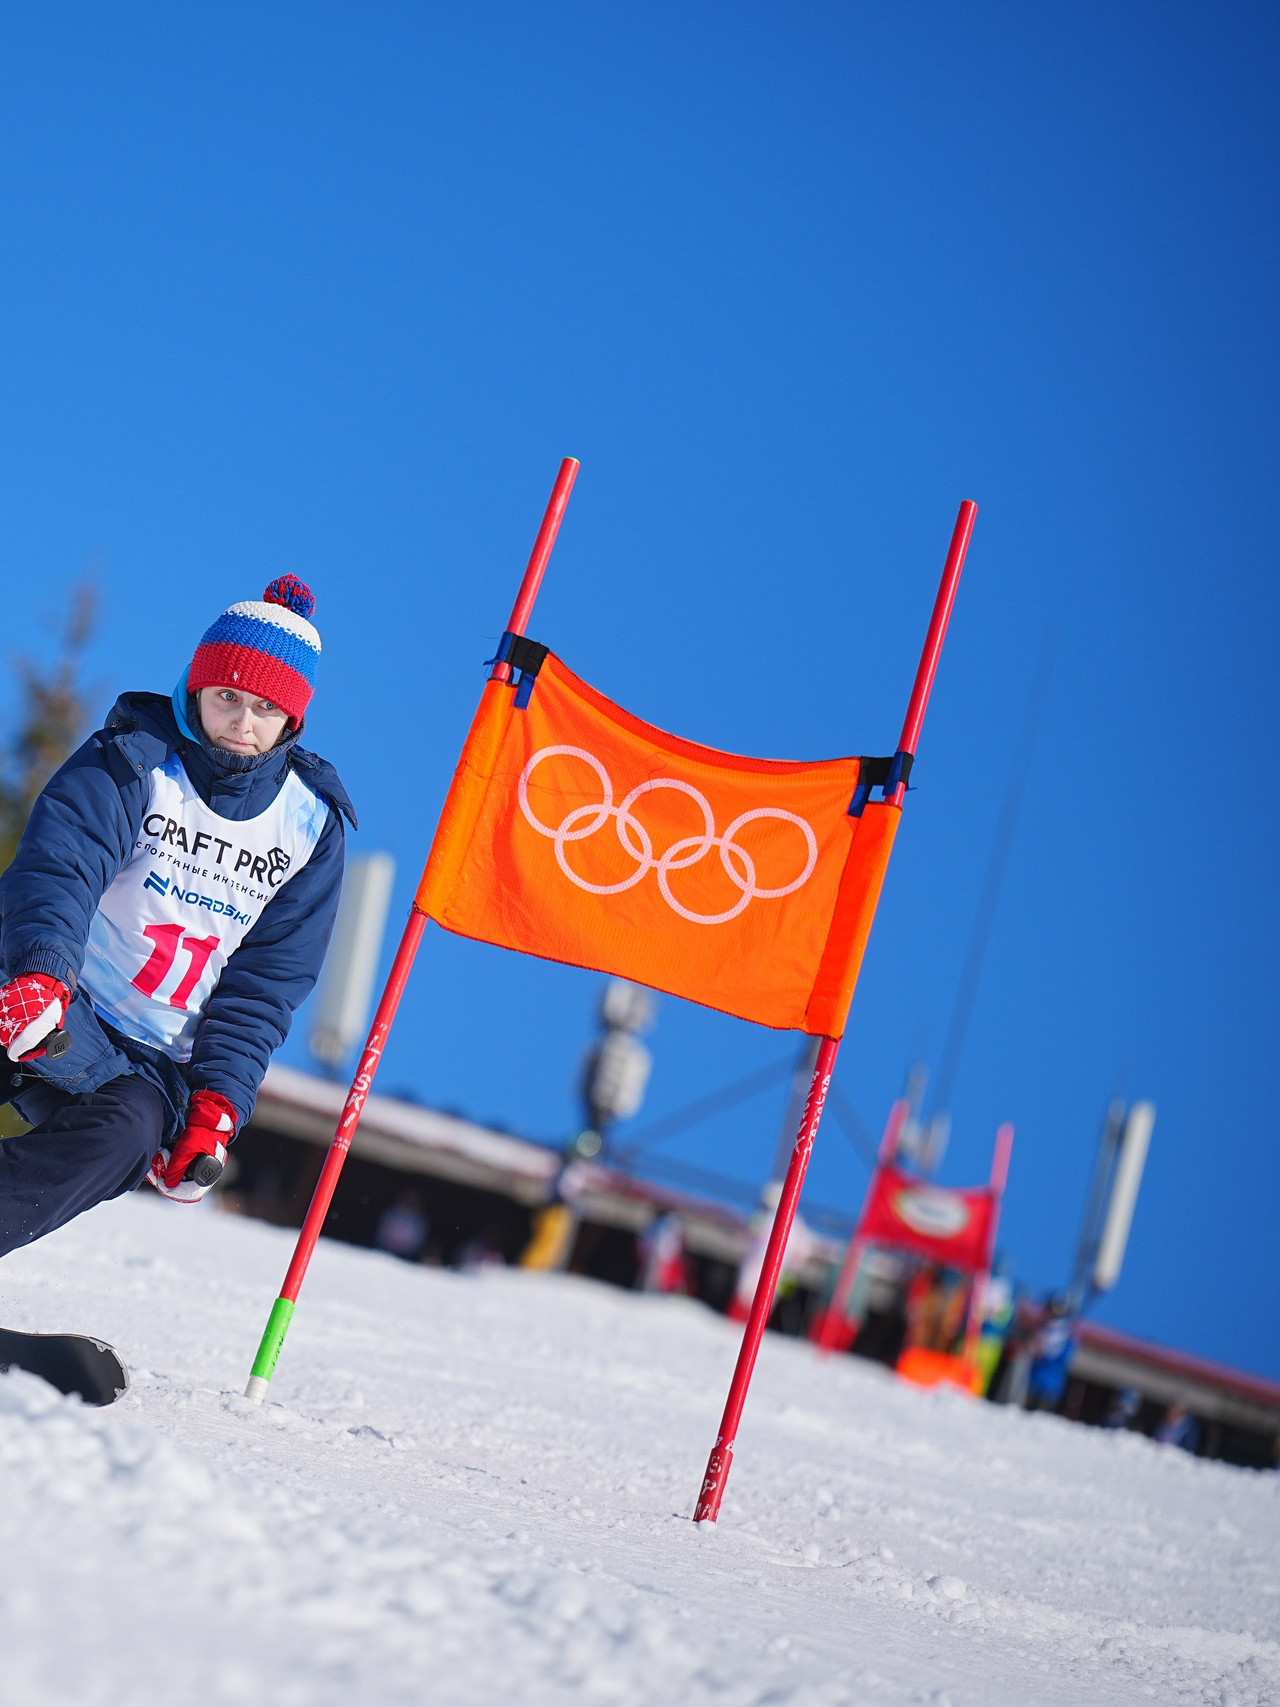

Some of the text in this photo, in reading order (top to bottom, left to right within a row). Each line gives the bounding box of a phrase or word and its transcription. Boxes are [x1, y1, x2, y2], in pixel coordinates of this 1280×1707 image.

[143, 814, 285, 888] CRAFT PRO
[171, 885, 252, 926] NORDSKI
[130, 923, 221, 1010] 11
[343, 1035, 381, 1128] LISKI
